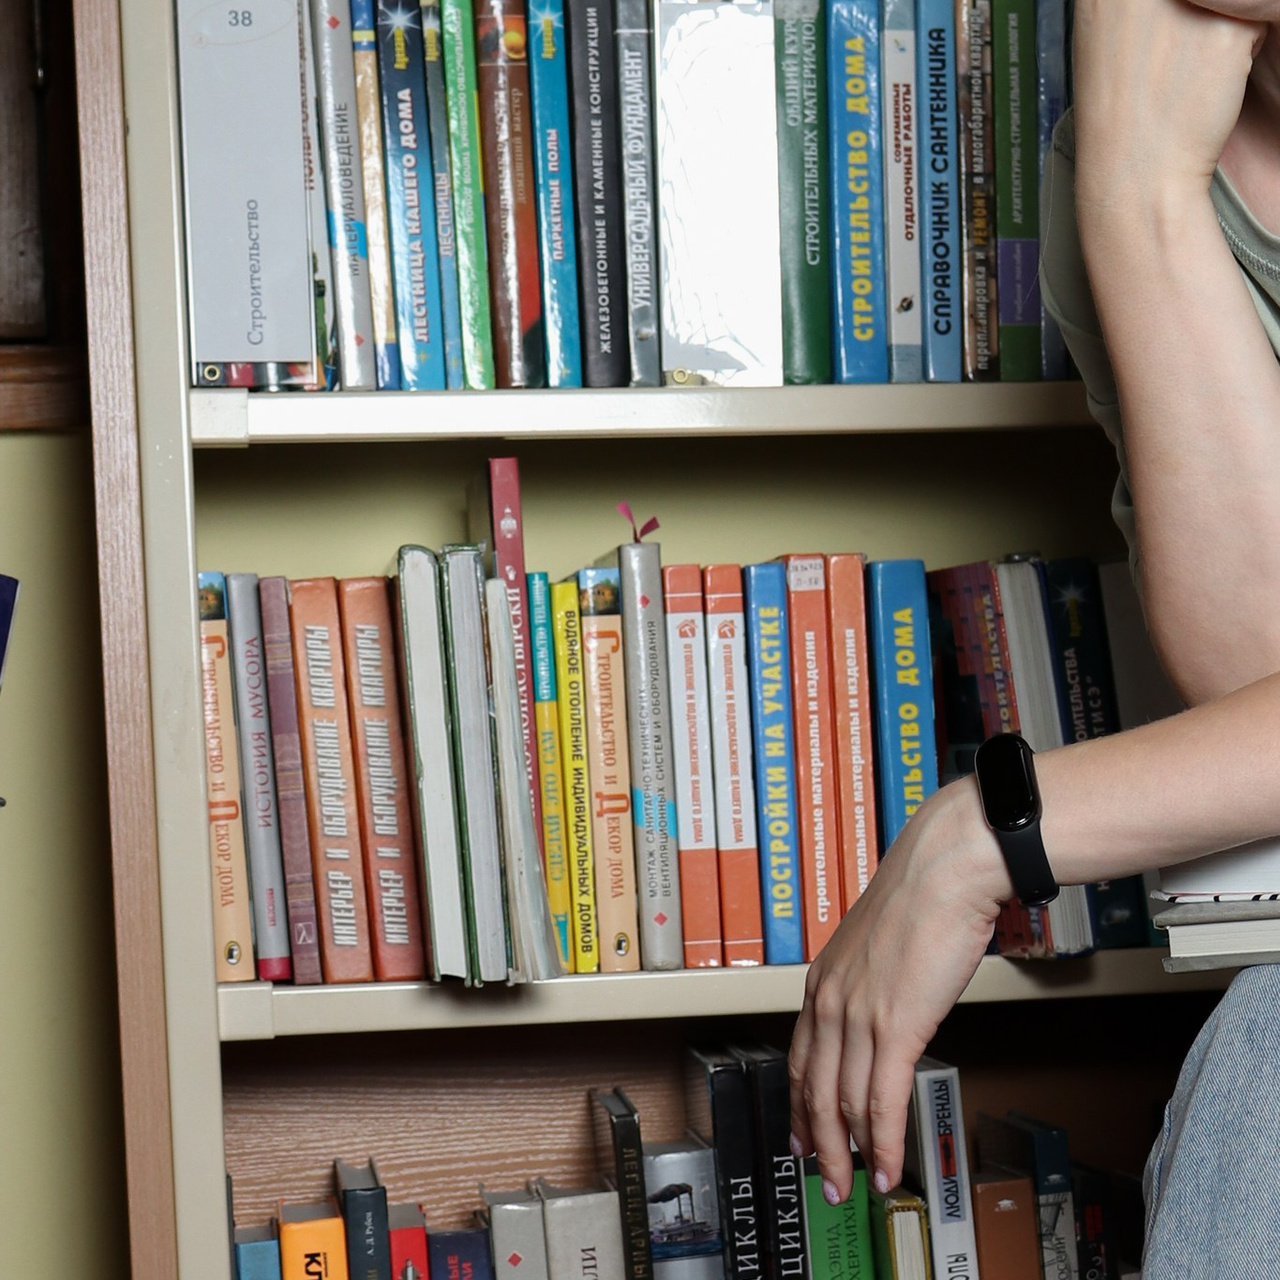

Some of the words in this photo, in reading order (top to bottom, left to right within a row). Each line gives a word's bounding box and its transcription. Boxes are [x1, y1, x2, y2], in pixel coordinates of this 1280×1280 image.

[229, 11, 252, 27] 38
[587, 7, 601, 114] КОНСТРУКЦИИ
[623, 48, 648, 154] ФУНДАМЕНТ
[844, 37, 868, 114] ДОМА
[928, 29, 948, 173] САНТЕХНИКА
[396, 89, 417, 148] ДОМА
[546, 129, 560, 171] ПОЛЫ
[590, 119, 603, 199] КАМЕННЫЕ
[402, 154, 422, 234] НАШЕГО
[548, 180, 563, 261] ПАРКЕТНЫЕ
[593, 205, 605, 213] И
[628, 160, 652, 309] УНИВЕРСАЛЬНЫЙ
[243, 200, 266, 345] Строительство
[847, 130, 873, 340] СТРОИТЕЛЬСТВО
[931, 183, 951, 335] СПРАВОЧНИК
[406, 240, 429, 342] ЛЕСТНИЦА
[593, 220, 612, 353] ЖЕЛЕЗОБЕТОННЫЕ
[244, 636, 265, 718] МУСОРА
[305, 625, 335, 707] КВАРТИРЫ
[565, 611, 579, 675] ВОДЯНОЕ
[758, 606, 782, 714] УЧАСТКЕ
[803, 632, 818, 697] изделия
[567, 681, 581, 762] ОТОПЛЕНИЕ
[764, 723, 785, 756] НА
[808, 700, 817, 709] и
[252, 732, 272, 828] ИСТОРИЯ
[313, 718, 347, 836] ОБОРУДОВАНИЕ
[807, 712, 824, 805] материалы
[327, 849, 348, 859] И
[572, 767, 590, 897] ИНДИВИДУАЛЬНЫХ
[766, 767, 793, 917] ПОСТРОЙКИ
[813, 809, 830, 922] строительные
[328, 870, 358, 946] ИНТЕРЬЕР
[579, 904, 592, 953] ДОМОВ
[934, 1080, 953, 1136] БРЕНДЫ
[944, 1175, 962, 1218] ЛЮДИ
